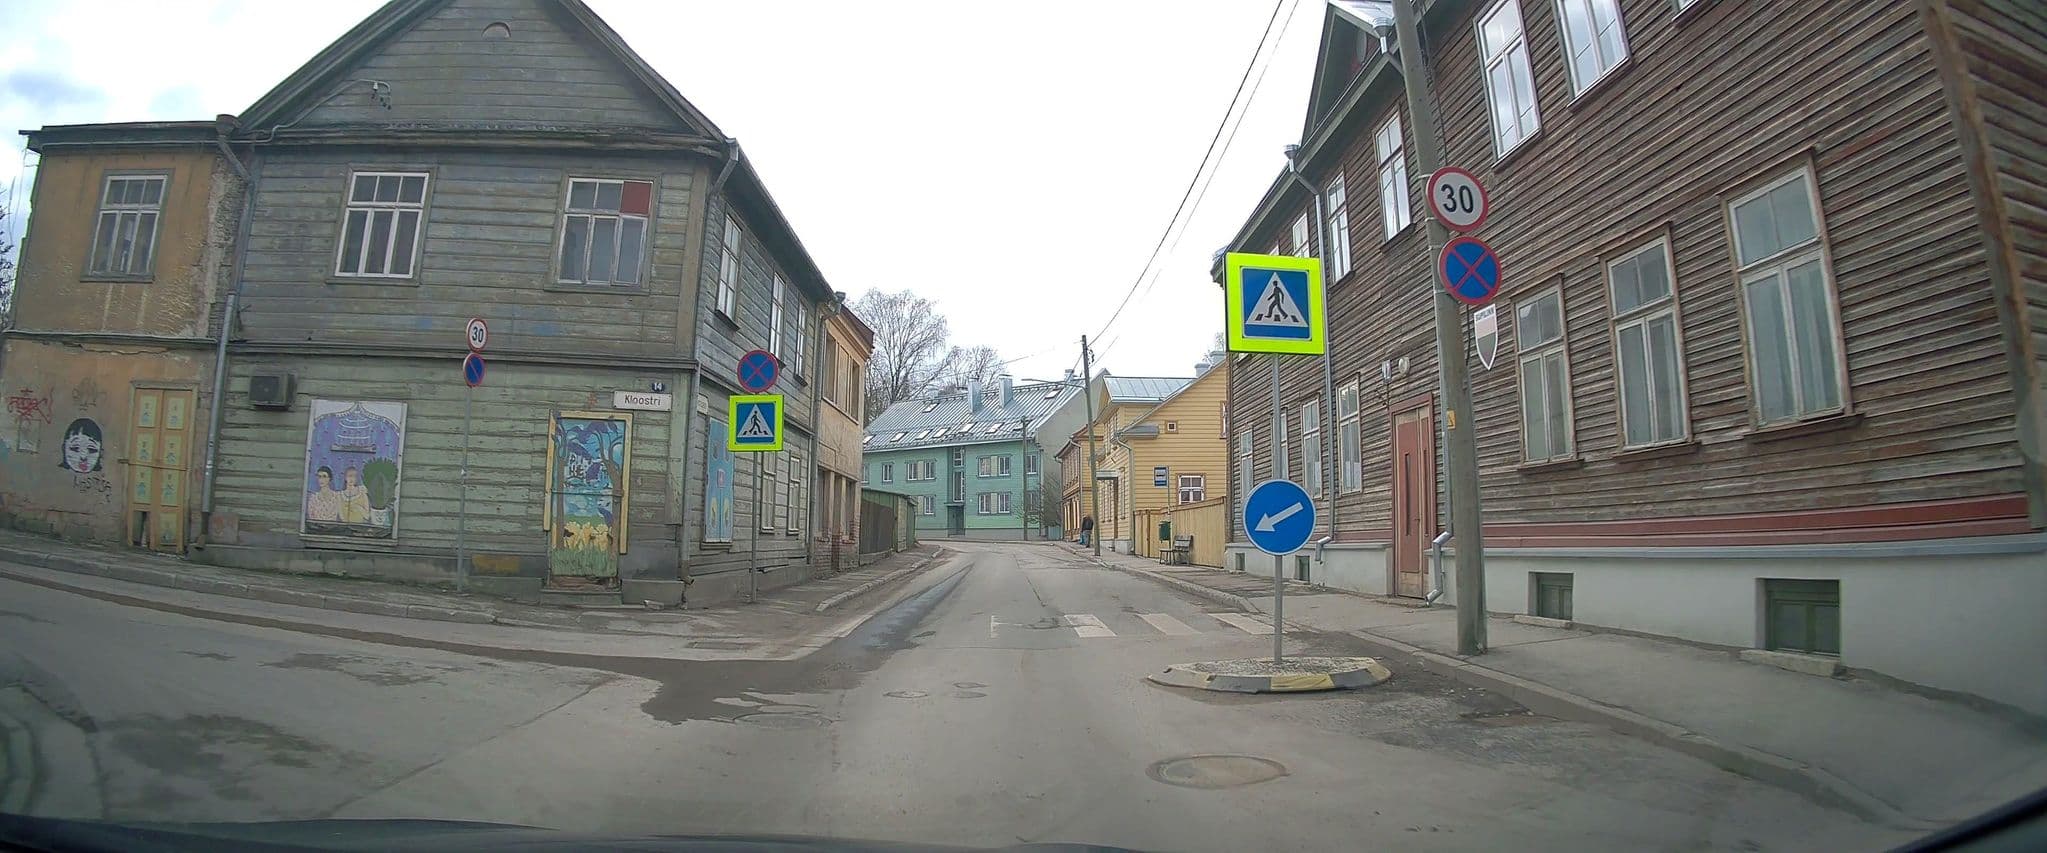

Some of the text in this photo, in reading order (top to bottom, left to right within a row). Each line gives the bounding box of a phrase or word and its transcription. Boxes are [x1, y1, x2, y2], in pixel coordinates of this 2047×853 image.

[1440, 184, 1474, 214] 30
[472, 326, 484, 343] 30
[654, 382, 662, 391] 14
[624, 394, 661, 406] Kloostri
